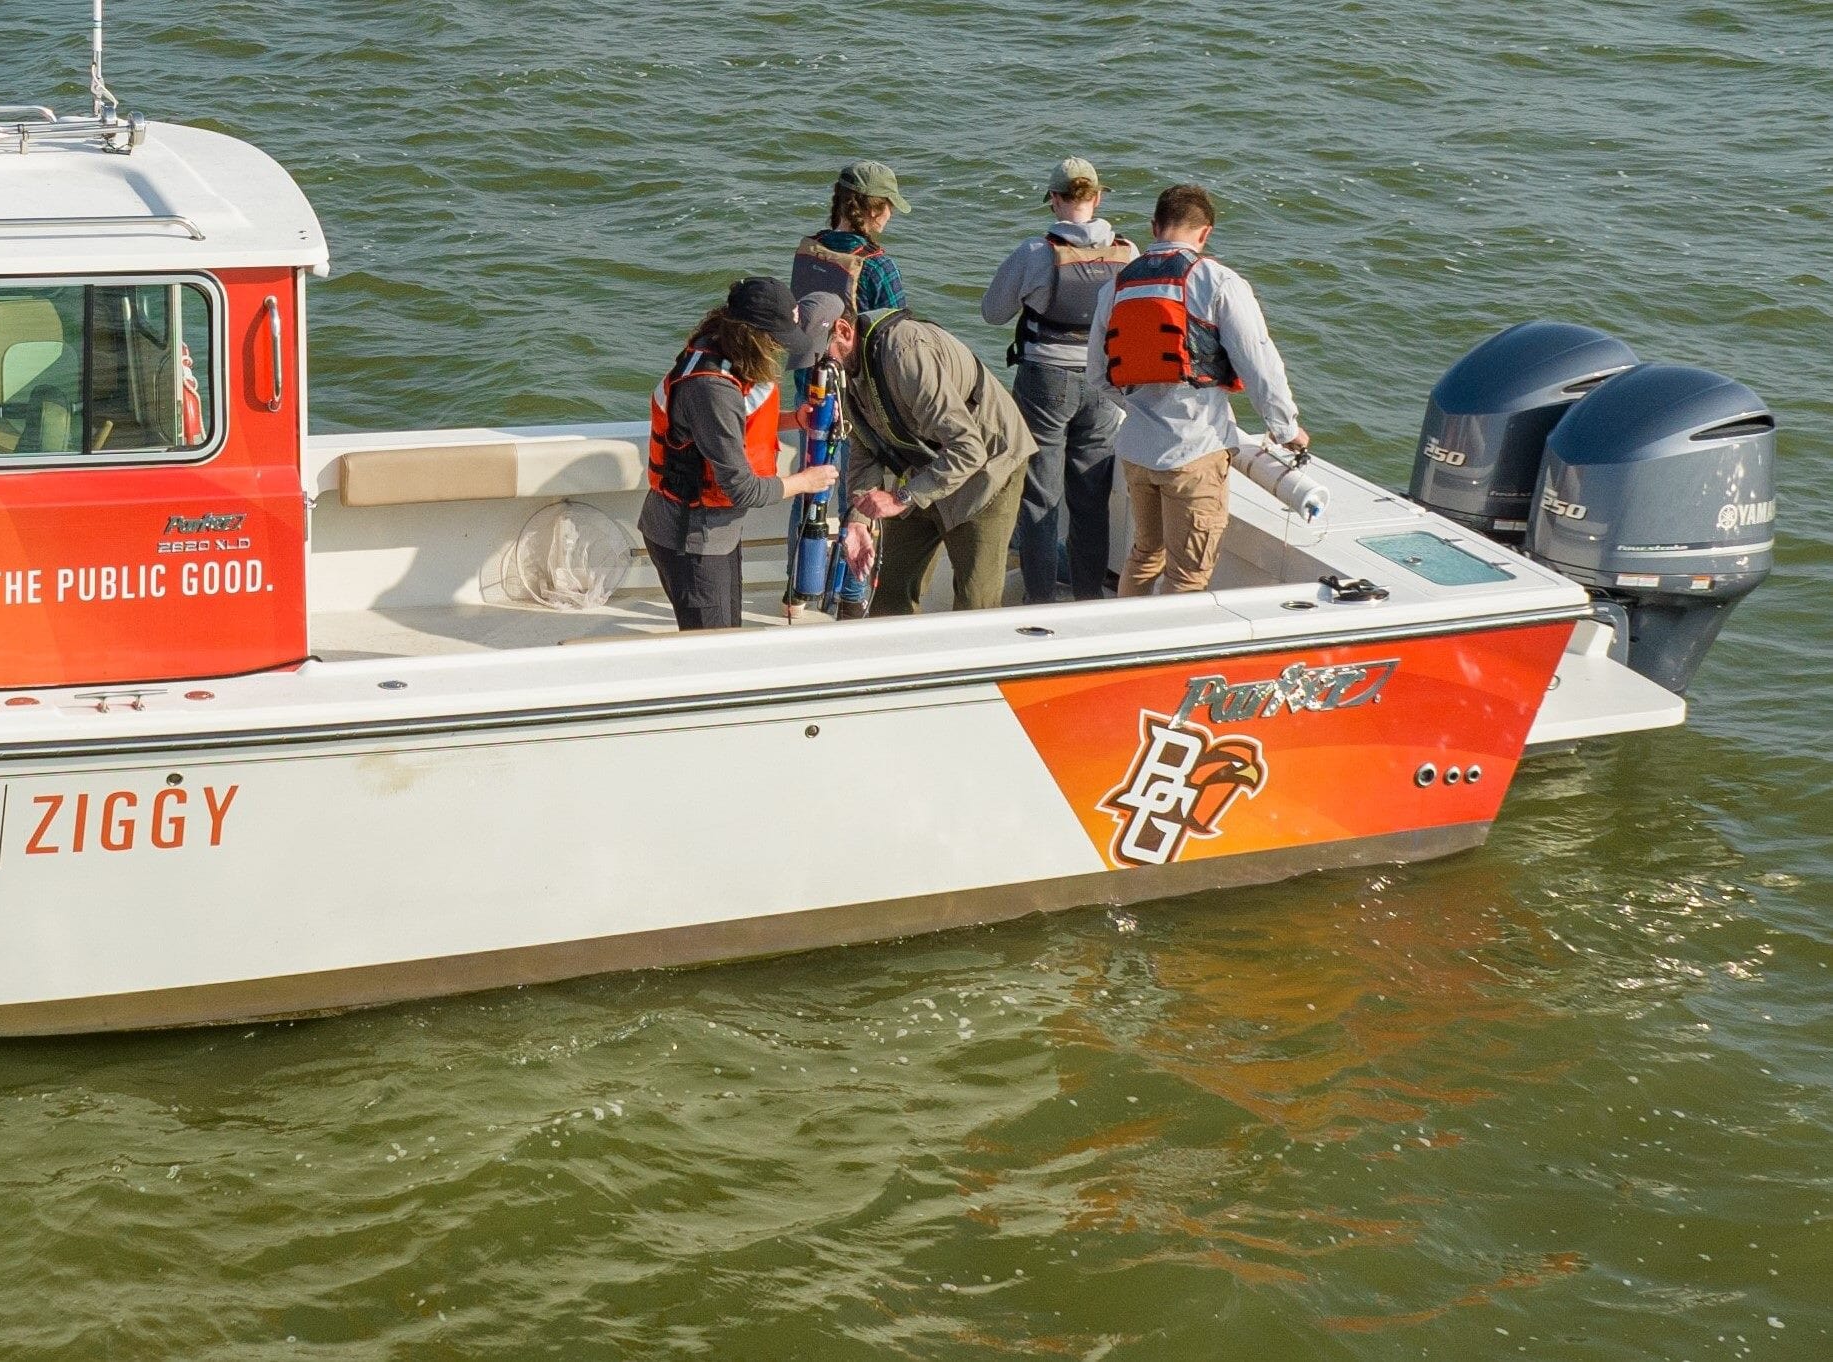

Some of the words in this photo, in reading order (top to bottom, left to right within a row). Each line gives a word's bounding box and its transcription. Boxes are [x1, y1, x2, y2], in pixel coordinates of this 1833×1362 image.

[1423, 441, 1466, 466] 250
[1539, 495, 1587, 520] 250
[215, 537, 251, 551] XLD
[57, 563, 167, 603] PUBLIC
[181, 558, 274, 597] GOOD.
[1168, 660, 1402, 730] Parker
[24, 783, 240, 855] ZIGGY
